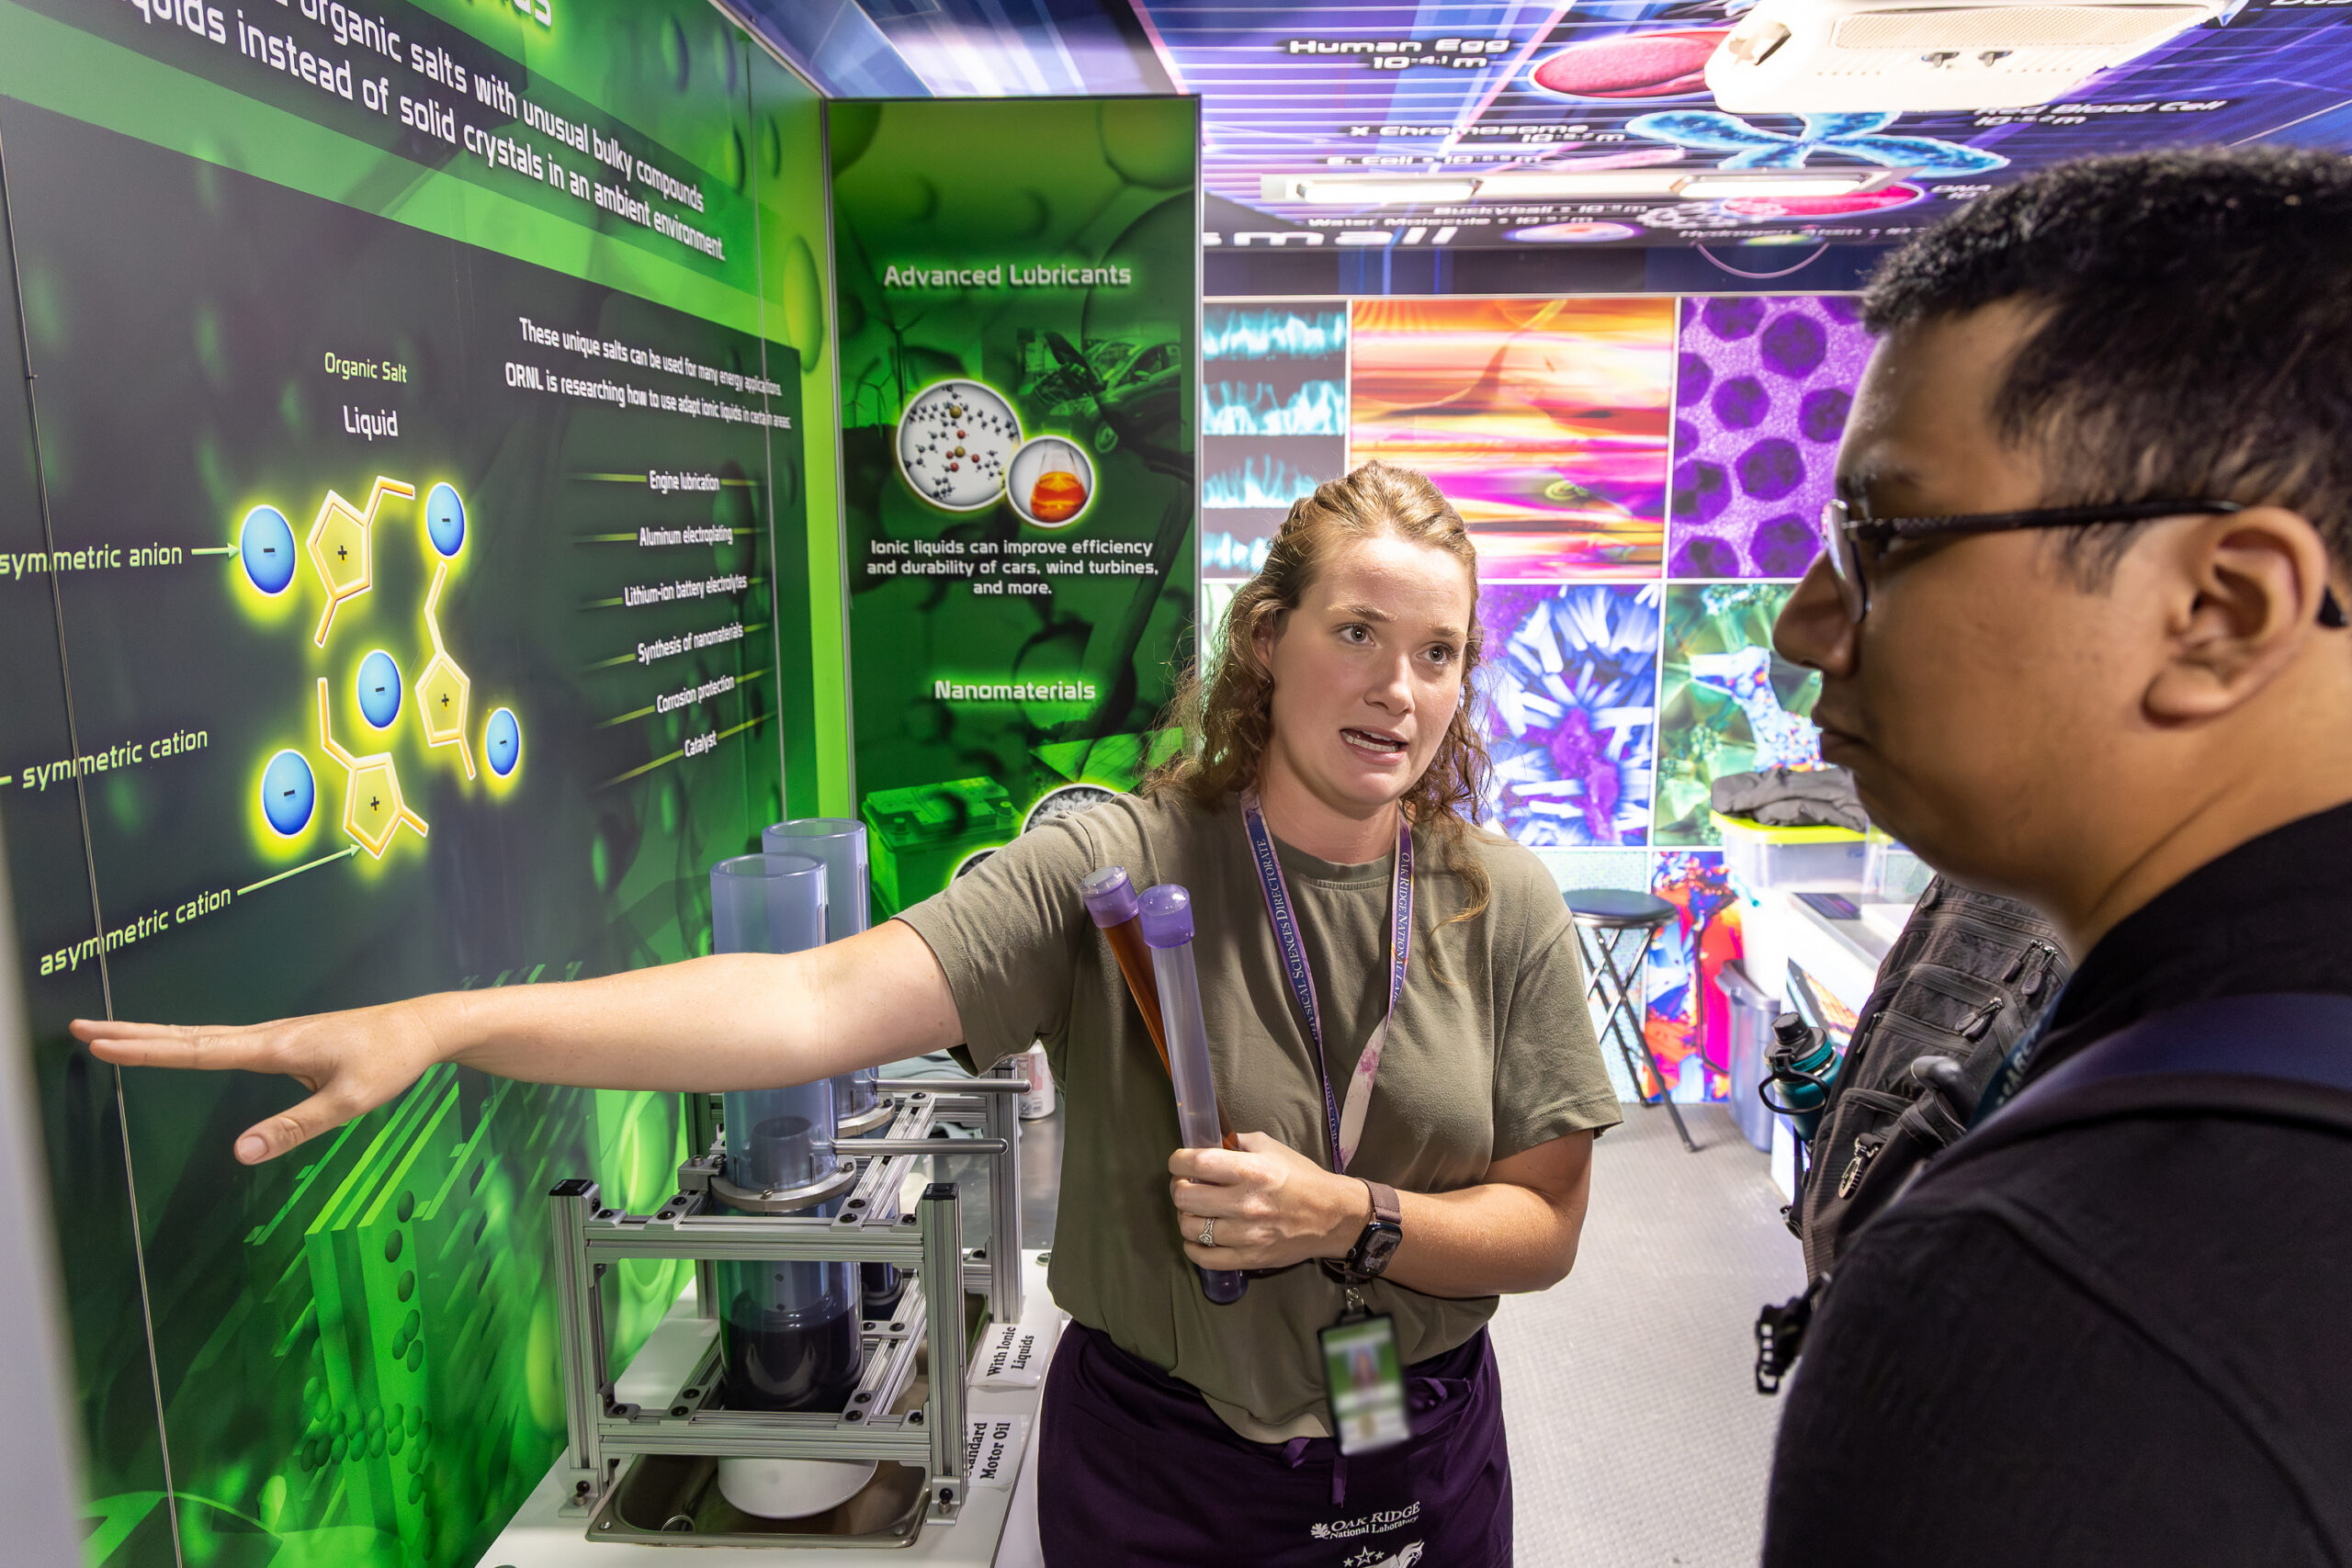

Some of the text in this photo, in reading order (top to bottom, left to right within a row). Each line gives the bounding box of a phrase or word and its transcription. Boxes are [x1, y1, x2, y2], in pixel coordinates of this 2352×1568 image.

[1289, 38, 1510, 54] Human Egg
[2050, 102, 2158, 115] Blood
[2158, 100, 2228, 112] Cell
[237, 9, 354, 100] instead
[362, 76, 390, 115] of
[399, 96, 456, 144] solid
[463, 124, 544, 181] crystals
[548, 153, 565, 190] in
[569, 170, 590, 201] an
[594, 182, 651, 228] ambient
[653, 209, 726, 262] environment.
[411, 42, 468, 93] salts
[473, 73, 518, 118] with
[522, 98, 589, 154] unusual
[593, 128, 633, 182] bulky
[636, 159, 705, 213] compounds
[1379, 123, 1589, 137] Chromosome
[883, 264, 1132, 288] Advanced Lubricants
[324, 351, 407, 383] Organic Salt
[518, 316, 560, 348] These
[562, 331, 600, 358] unique
[603, 338, 628, 363] salts
[630, 347, 648, 367] can
[649, 348, 662, 371] be
[662, 355, 684, 375] used
[684, 357, 697, 378] for
[697, 364, 718, 387] many
[719, 368, 743, 392] energy
[505, 362, 544, 391] ORNL
[546, 369, 559, 393] is
[560, 375, 626, 409] researching
[627, 384, 648, 407] how
[649, 388, 660, 408] to
[661, 393, 677, 412] use
[678, 393, 701, 418] adapt
[701, 397, 719, 417] ionic
[719, 400, 742, 423] liquids
[742, 405, 750, 423] in
[343, 404, 399, 441] Liquid
[649, 469, 720, 494] Engine lubrication
[639, 525, 733, 547] Aluminum electroplating
[870, 539, 1153, 558] Ionic liquids can improve efficiency
[130, 542, 183, 567] anion
[866, 559, 1159, 578] and durability of cars, wind turbines,
[624, 573, 748, 607] Lithium-ion battery electrolytes
[973, 580, 1053, 595] and more.
[638, 621, 744, 665] Synthesis of nanomaterials
[656, 674, 736, 714] Corrosion protection
[934, 680, 1096, 701] Nanomaterials
[22, 729, 209, 792] symmetric cation
[684, 730, 718, 758] Catalyst
[1256, 838, 1289, 920] DIRECTORATE
[1400, 852, 1411, 875] OAK
[1397, 876, 1409, 914] RIDGE
[40, 888, 232, 976] asymmetric cation
[1395, 914, 1408, 972] NATIONAL
[1280, 921, 1305, 979] SCIENCES
[987, 1326, 1016, 1377] With Ionic
[1011, 1335, 1035, 1371] Liquids
[967, 1422, 988, 1478] andard
[979, 1422, 1011, 1479] Motor Oil
[1329, 1516, 1419, 1540] National Laboratory
[1330, 1501, 1420, 1532] OAK RIDGE
